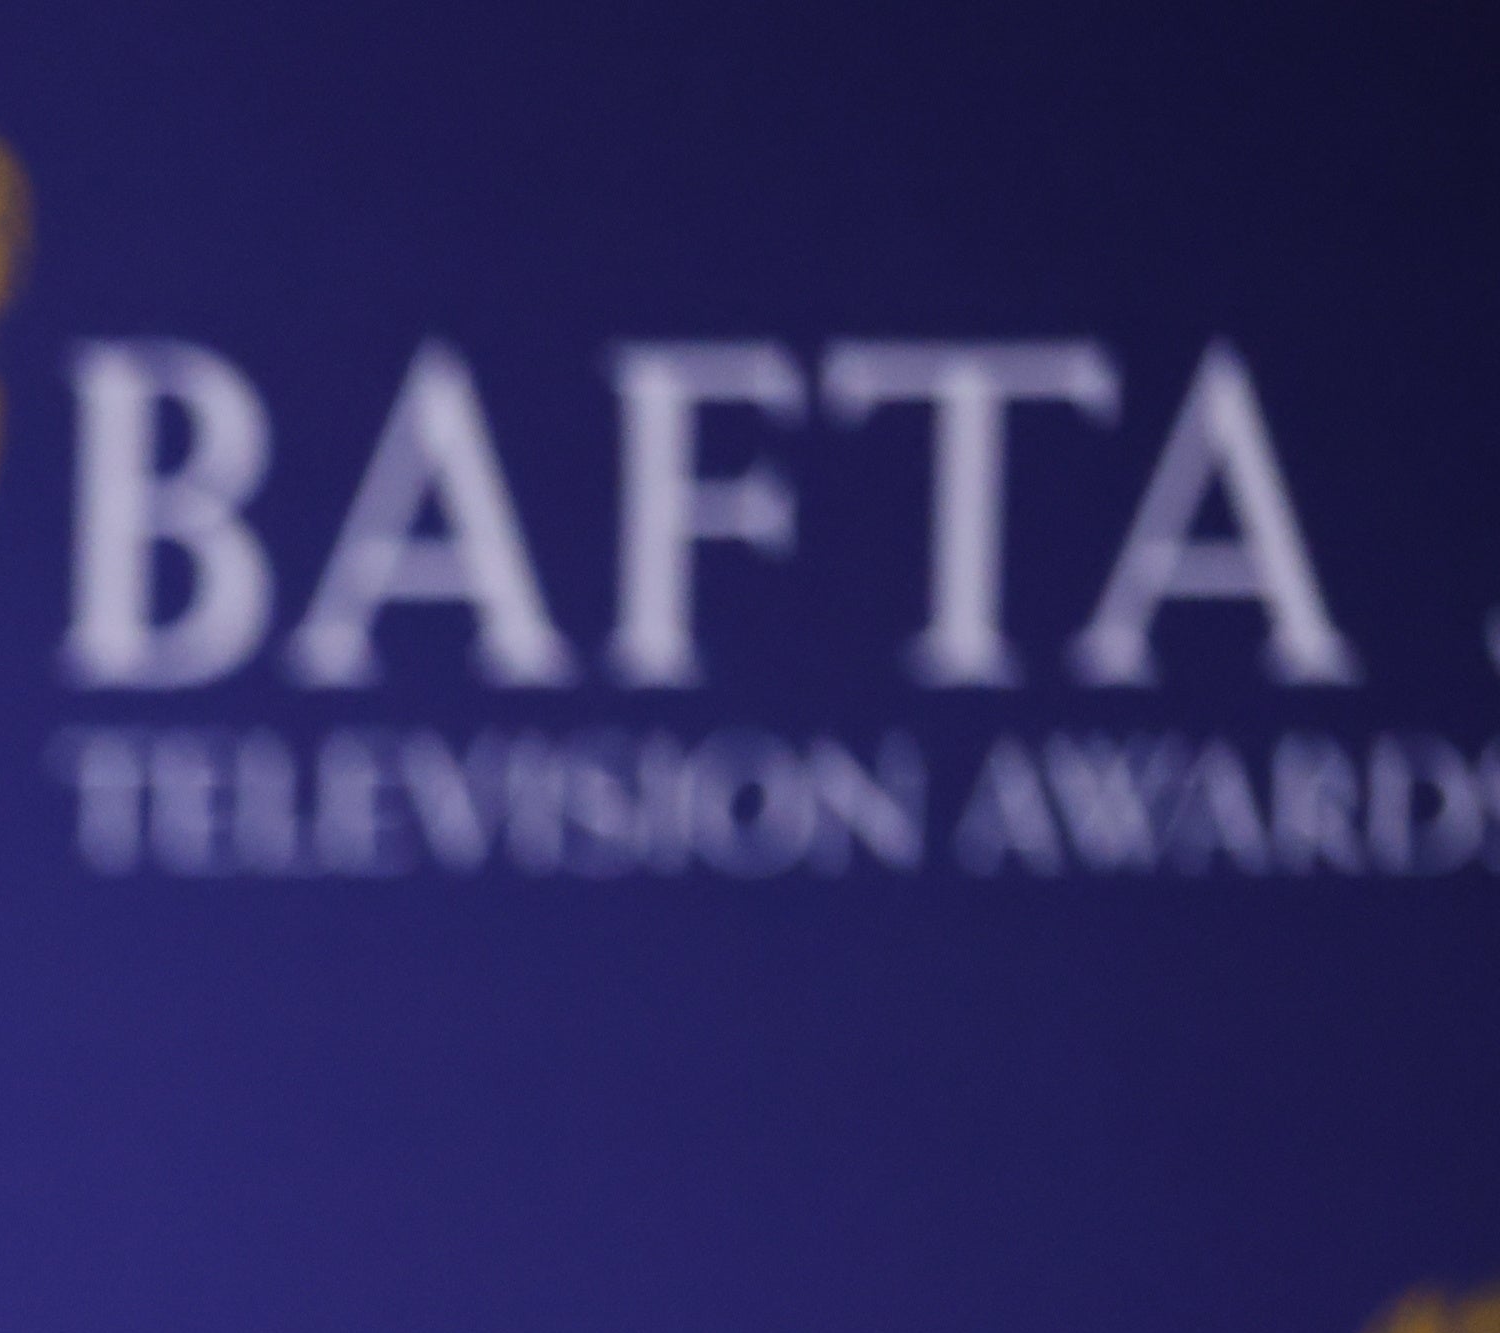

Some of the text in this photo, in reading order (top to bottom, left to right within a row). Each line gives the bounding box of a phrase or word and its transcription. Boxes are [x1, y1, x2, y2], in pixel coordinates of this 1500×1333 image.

[60, 338, 1362, 690] BAFTA
[48, 728, 1500, 878] TELEVISION AWARD
